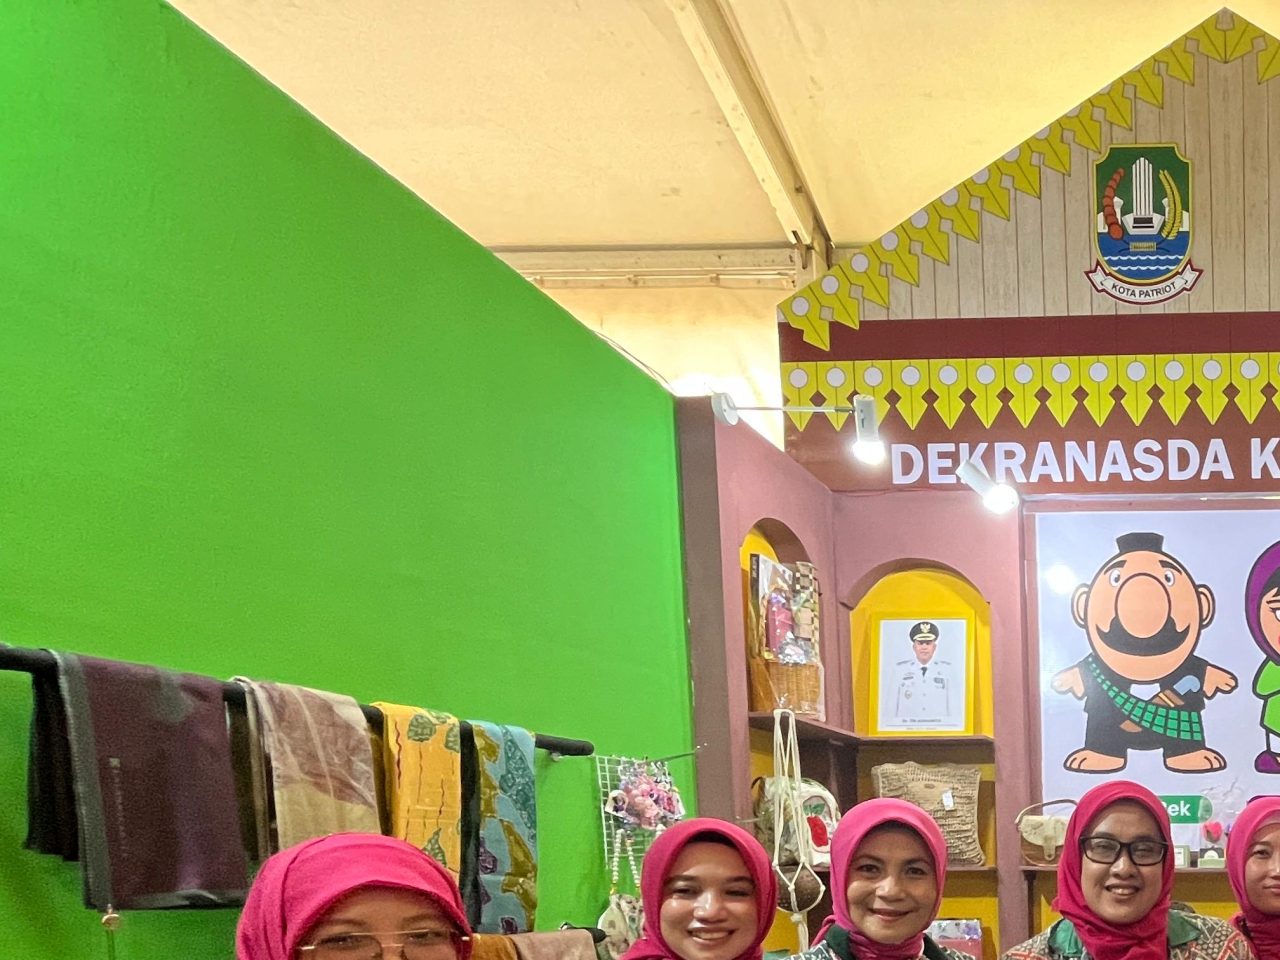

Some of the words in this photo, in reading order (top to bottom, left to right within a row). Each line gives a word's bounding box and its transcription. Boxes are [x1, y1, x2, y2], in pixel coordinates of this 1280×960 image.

[1111, 282, 1136, 298] KOTA
[1138, 281, 1177, 298] PATRIOT
[890, 437, 1235, 485] DEKRANASDA
[1161, 800, 1192, 817] ek
